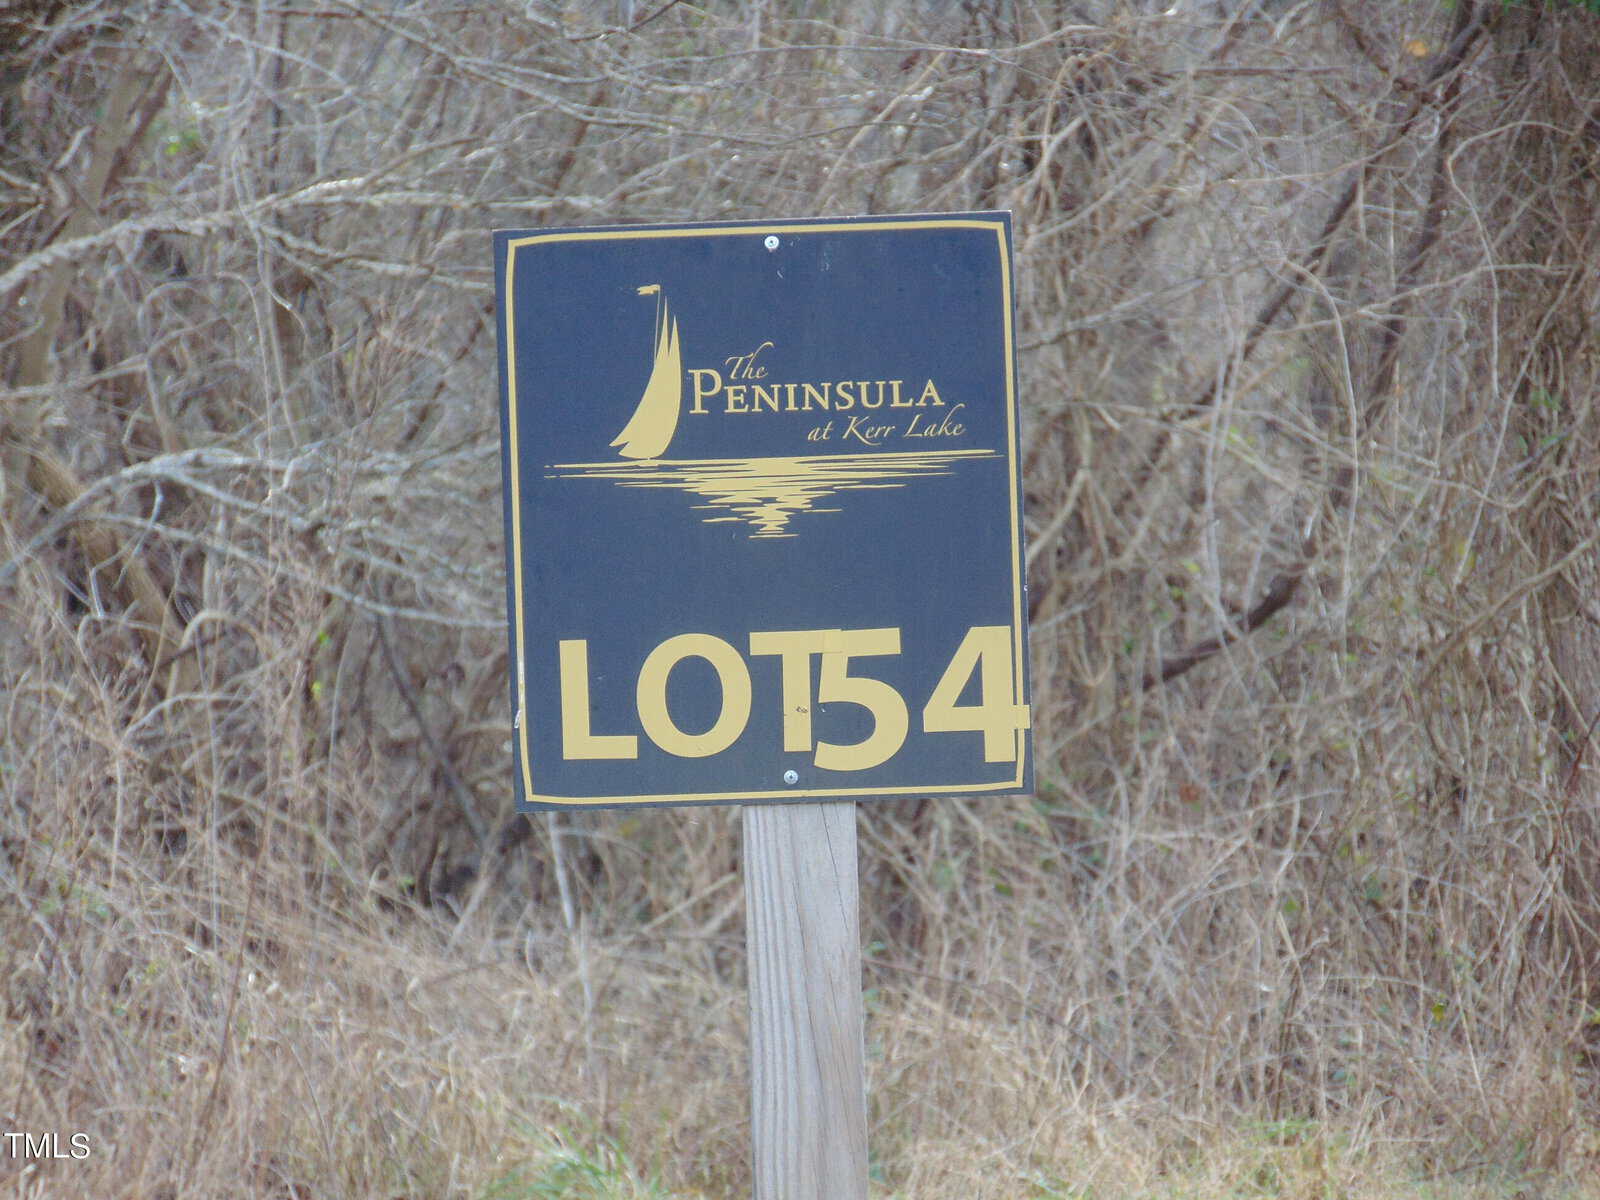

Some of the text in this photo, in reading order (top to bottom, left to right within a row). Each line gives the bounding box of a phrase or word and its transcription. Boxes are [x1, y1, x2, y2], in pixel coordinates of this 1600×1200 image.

[724, 341, 775, 381] The
[687, 367, 946, 415] PENINSULA
[807, 403, 966, 446] at Kerr Lake
[559, 625, 1031, 771] LOT 54
